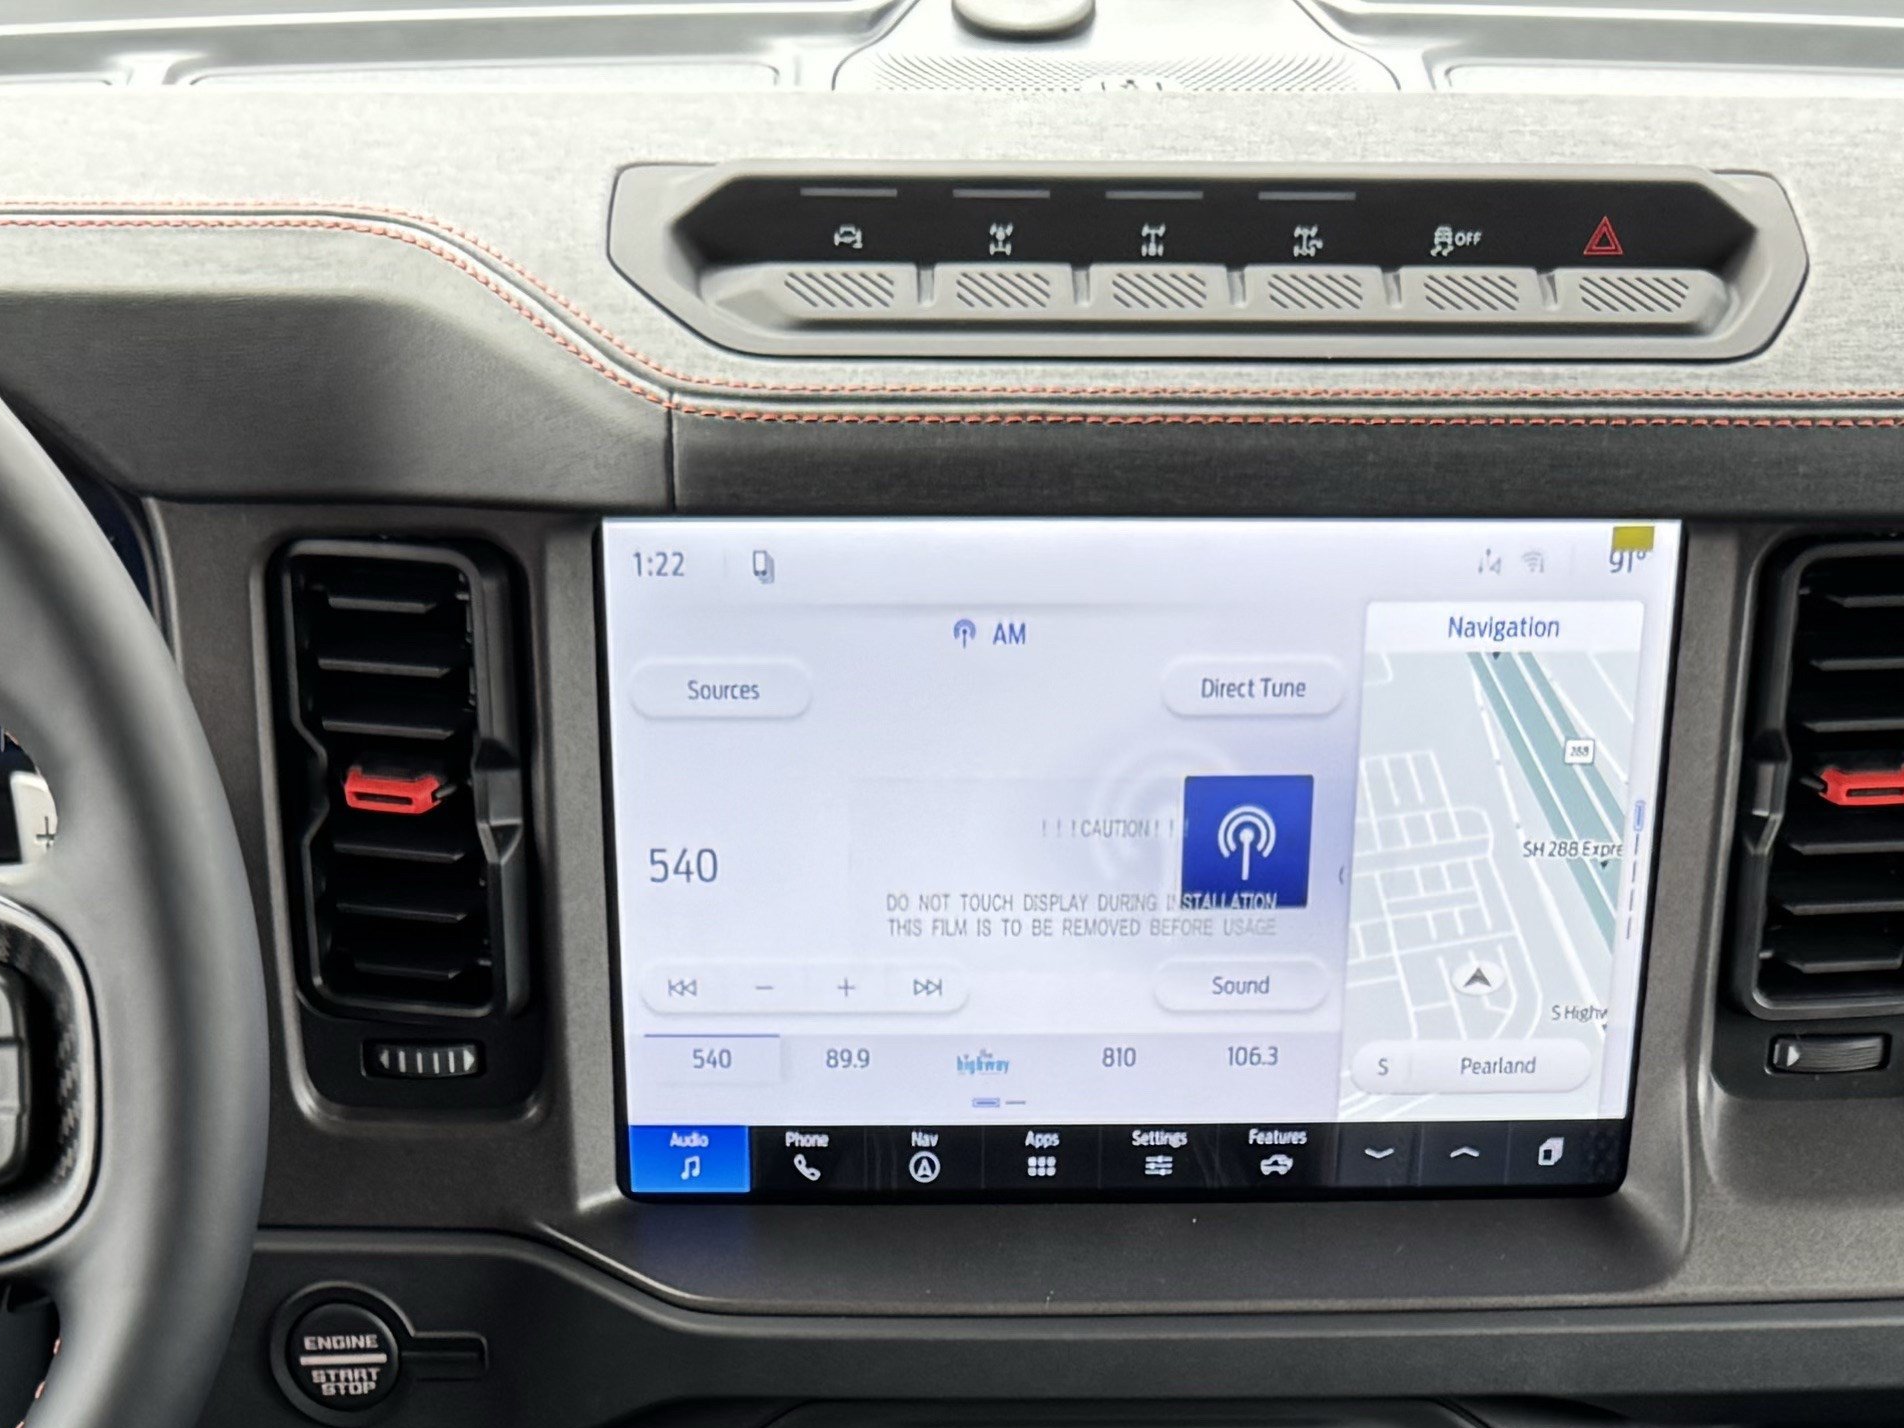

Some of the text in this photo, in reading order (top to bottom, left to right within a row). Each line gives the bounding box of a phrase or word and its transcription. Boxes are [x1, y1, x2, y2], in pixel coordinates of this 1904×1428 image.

[1454, 230, 1482, 247] OFF
[632, 550, 685, 577] 1:22
[992, 622, 1027, 645] AM
[1447, 616, 1561, 642] Navigation
[687, 679, 760, 701] Sources
[1200, 677, 1307, 700] Direct Tune
[1523, 840, 1545, 857] SH
[1548, 841, 1579, 857] 288
[649, 847, 719, 883] 540
[887, 893, 909, 912] DO
[919, 893, 950, 912] NOT
[959, 893, 1014, 912] TOUCH
[1023, 893, 1088, 912] DISPLAY
[1097, 893, 1158, 912] DURING
[887, 917, 1277, 937] THIS FILM IS TO BE REMOVED BEFORE USAGE
[1211, 976, 1270, 996] Sound
[1552, 1004, 1561, 1021] S
[692, 1049, 732, 1069] 540
[825, 1049, 870, 1068] 89.9
[1102, 1047, 1137, 1067] 810
[1227, 1047, 1279, 1067] 106.3
[1378, 1056, 1536, 1076] S Pearland
[670, 1132, 709, 1149] Audio
[785, 1131, 829, 1149] Phone
[911, 1131, 939, 1148] Nav
[1025, 1131, 1060, 1150] Apps
[1132, 1129, 1188, 1149] Settings
[1248, 1129, 1307, 1146] Features
[304, 1333, 378, 1351] ENGINE
[311, 1366, 381, 1384] START
[321, 1380, 376, 1396] STOP
